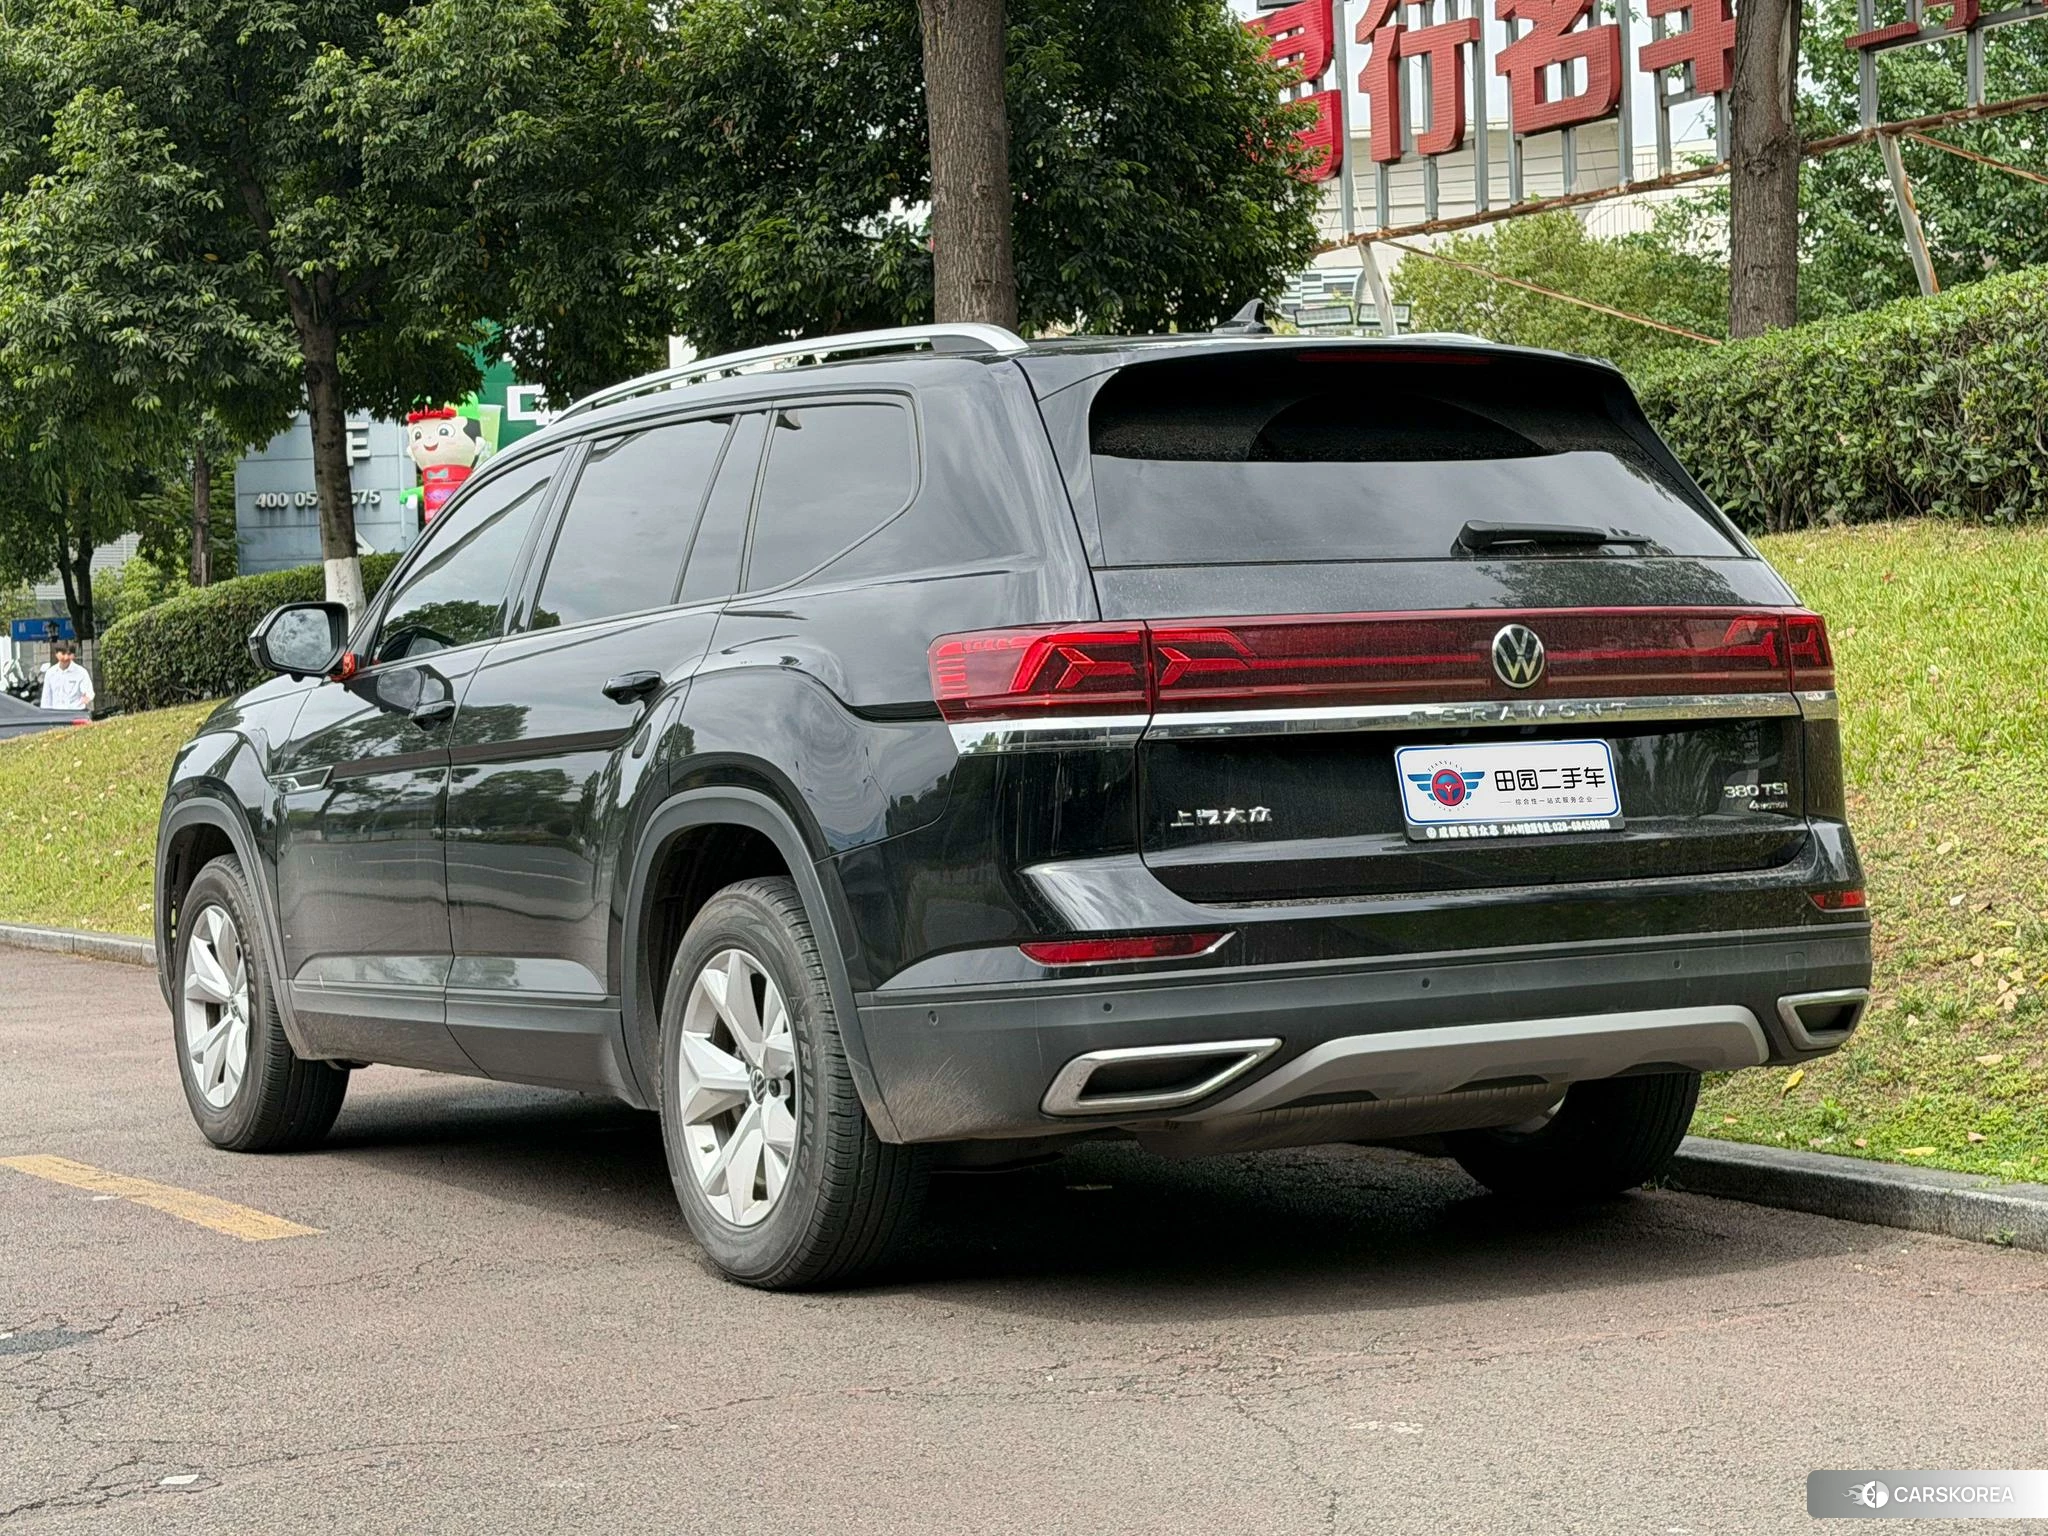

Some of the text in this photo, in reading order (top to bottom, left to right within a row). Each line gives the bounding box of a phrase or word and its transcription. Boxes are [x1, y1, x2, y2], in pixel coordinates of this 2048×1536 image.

[255, 492, 289, 508] 400
[1494, 767, 1606, 791] 田园二手车
[1723, 782, 1788, 798] 380 TSI
[1170, 806, 1273, 827] 上汽大众
